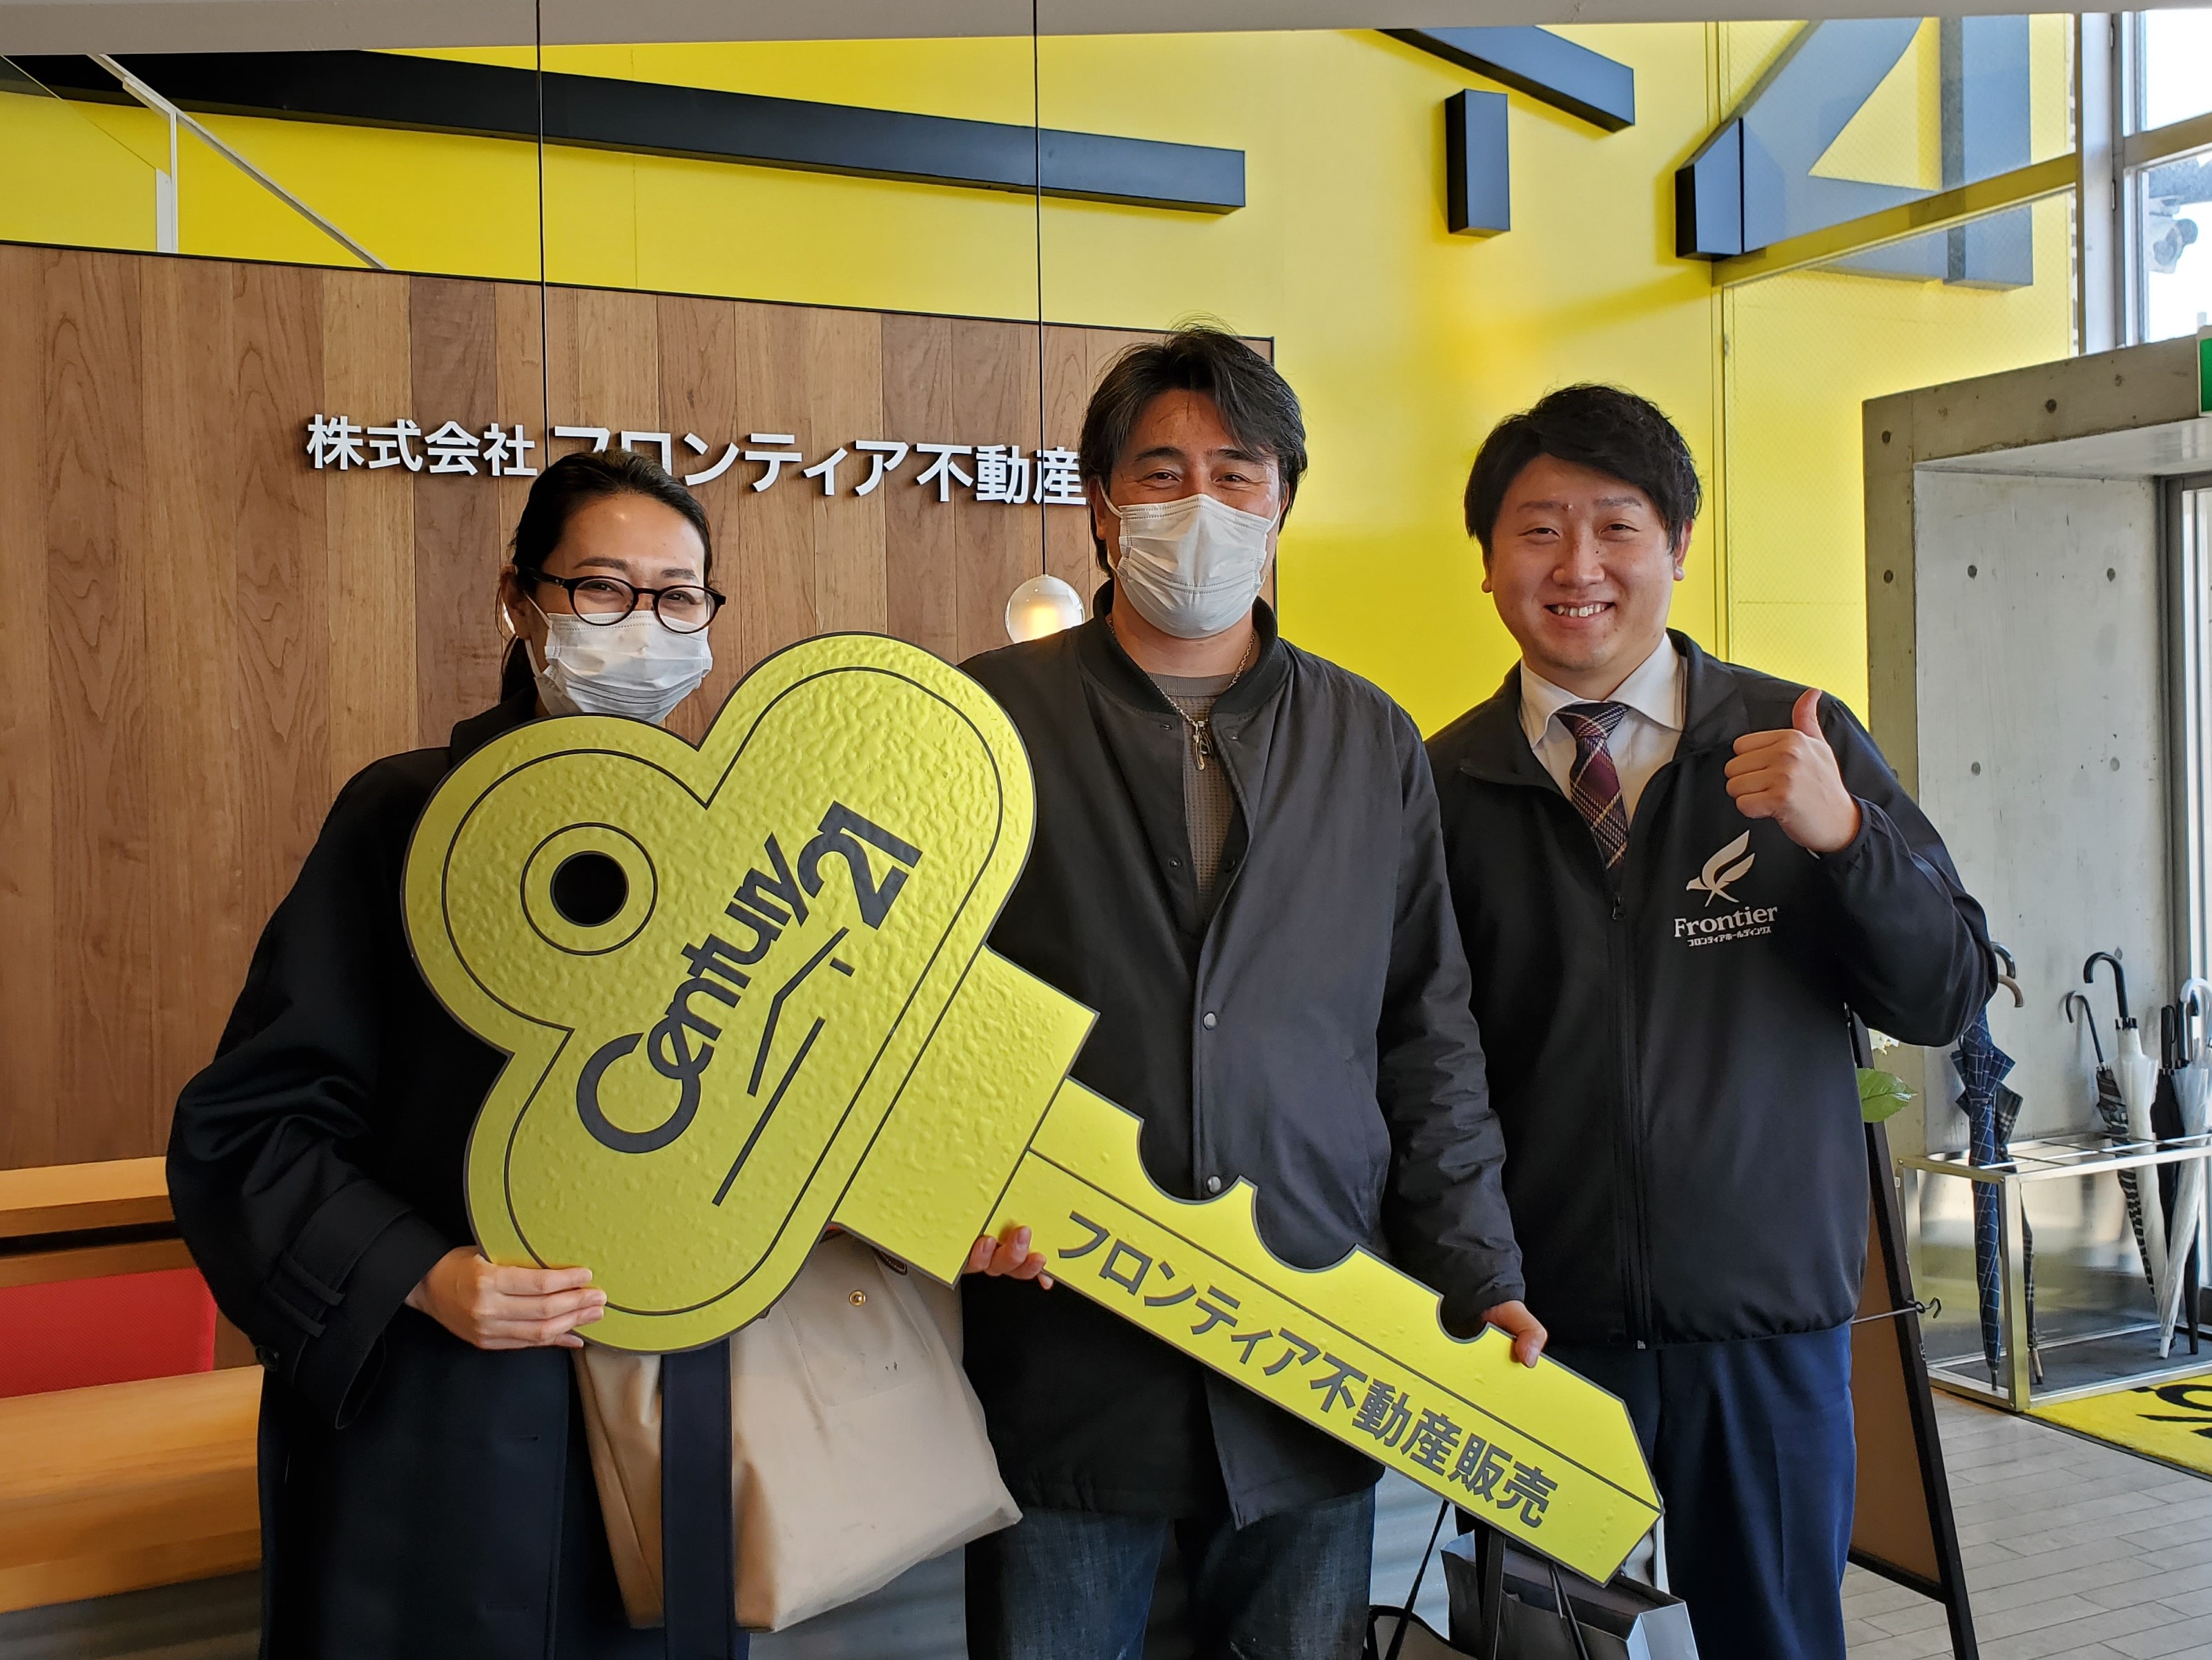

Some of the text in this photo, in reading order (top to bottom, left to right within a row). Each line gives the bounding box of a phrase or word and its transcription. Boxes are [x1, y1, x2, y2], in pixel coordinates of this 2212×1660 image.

[1674, 906, 1778, 938] Frontier
[1058, 1210, 1558, 1528] フロンティア不動産販売
